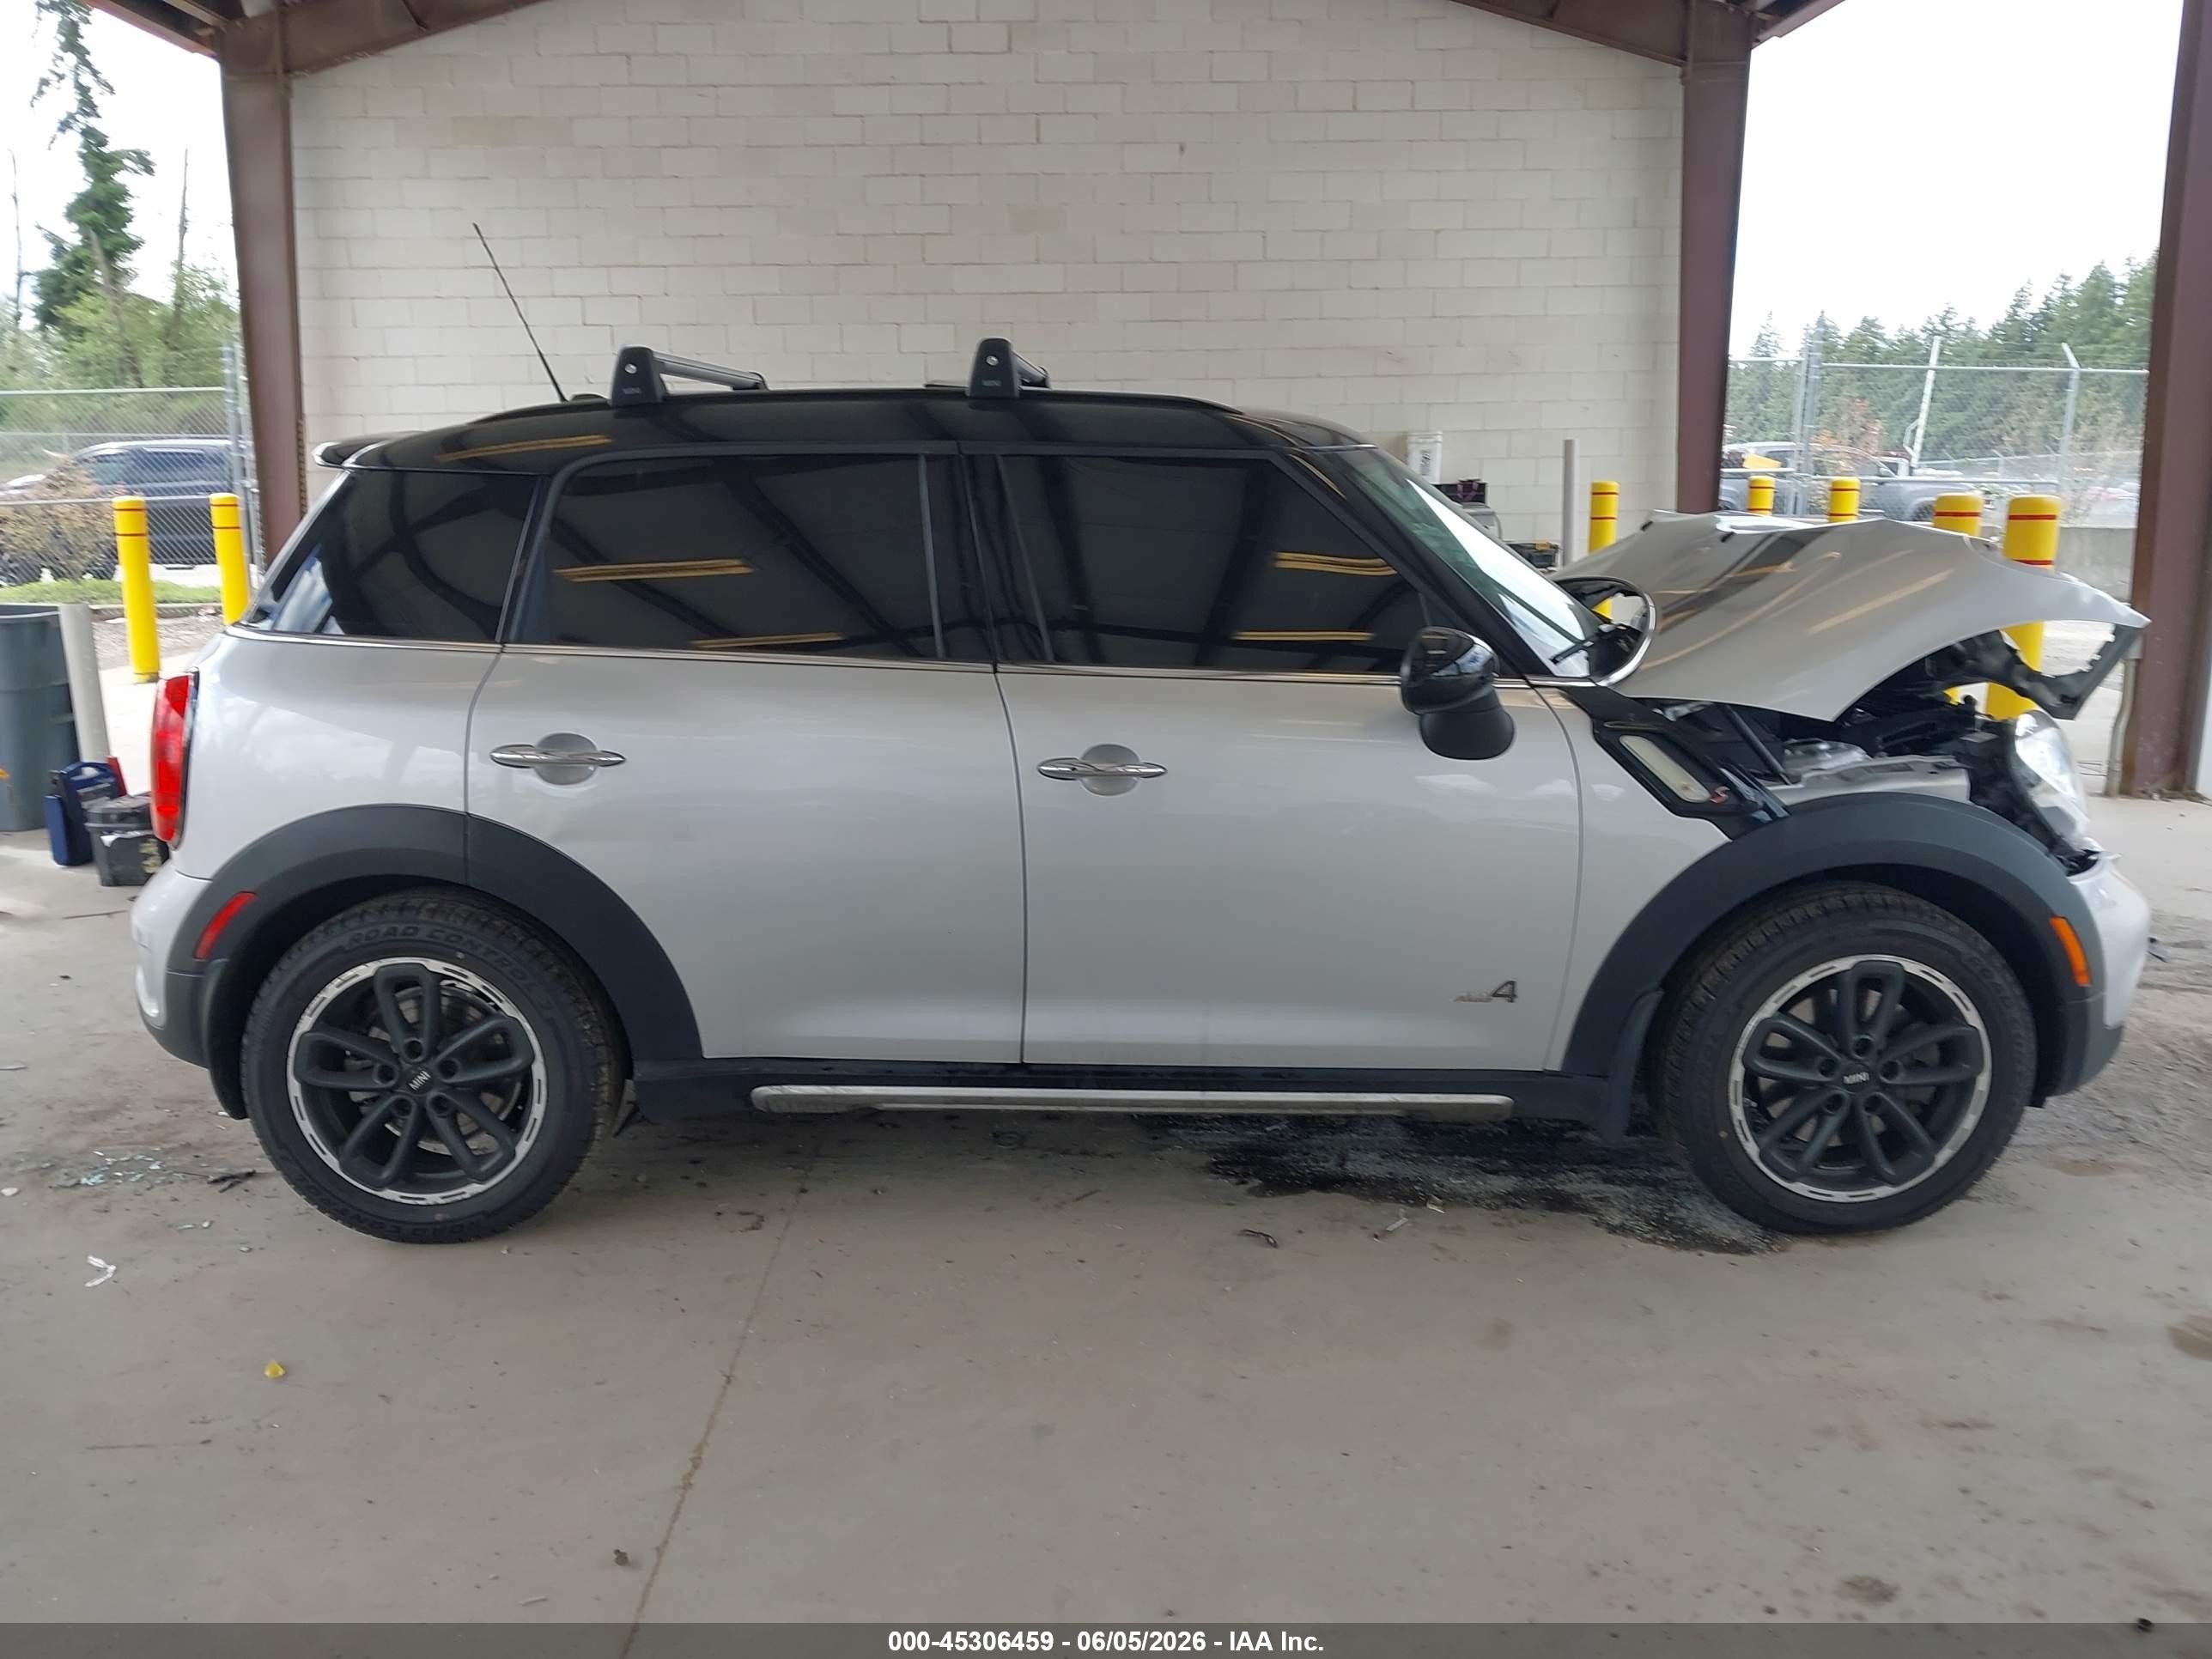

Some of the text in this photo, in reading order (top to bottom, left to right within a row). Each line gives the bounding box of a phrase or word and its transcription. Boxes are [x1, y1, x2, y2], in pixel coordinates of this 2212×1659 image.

[1710, 786, 1730, 805] S
[408, 1070, 432, 1091] MINI
[1843, 1071, 1869, 1085] MINI
